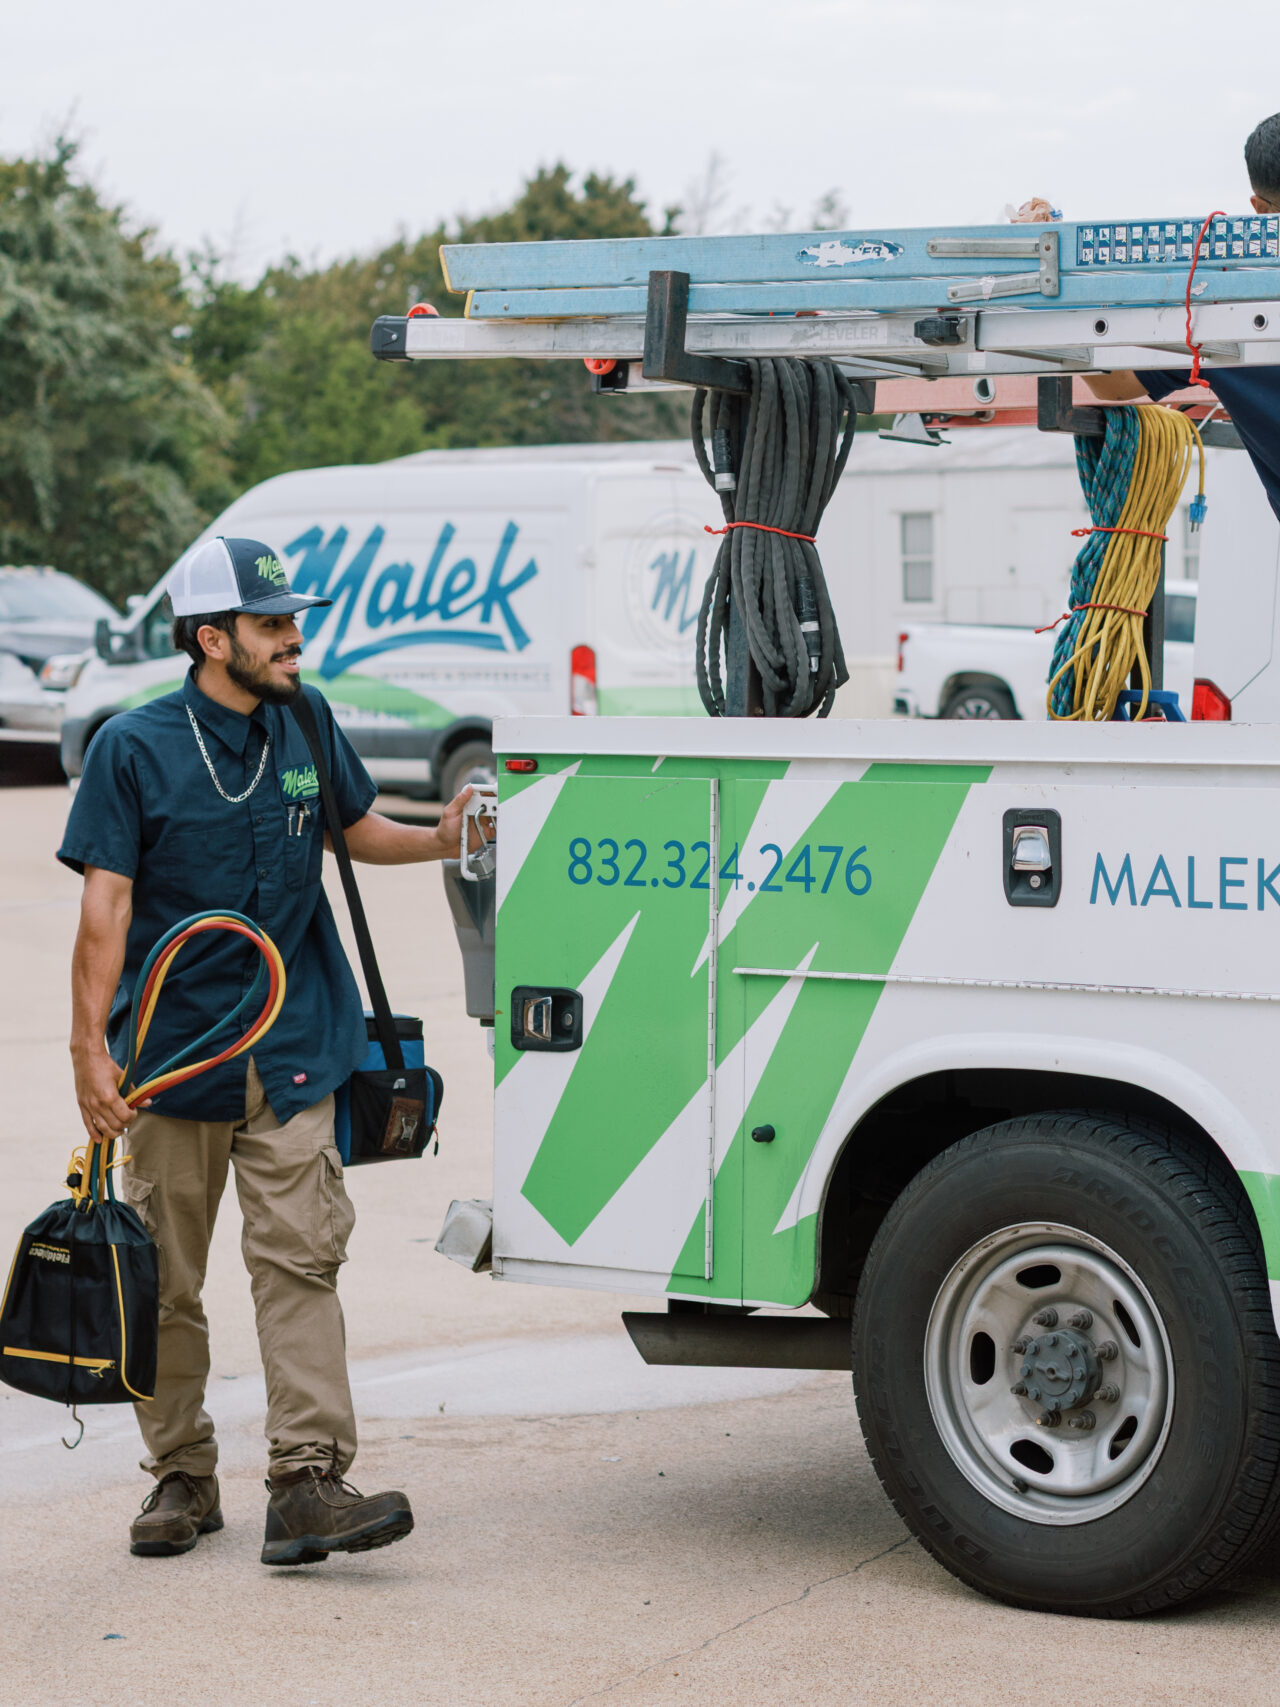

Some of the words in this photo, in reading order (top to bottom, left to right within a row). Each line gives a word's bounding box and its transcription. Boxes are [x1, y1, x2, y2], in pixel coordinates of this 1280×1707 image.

[818, 325, 879, 342] LEVELER
[283, 519, 539, 683] Malek
[281, 764, 319, 798] Malek
[567, 837, 872, 896] 832.324.2476
[1049, 1166, 1225, 1462] BRIDGESTONE
